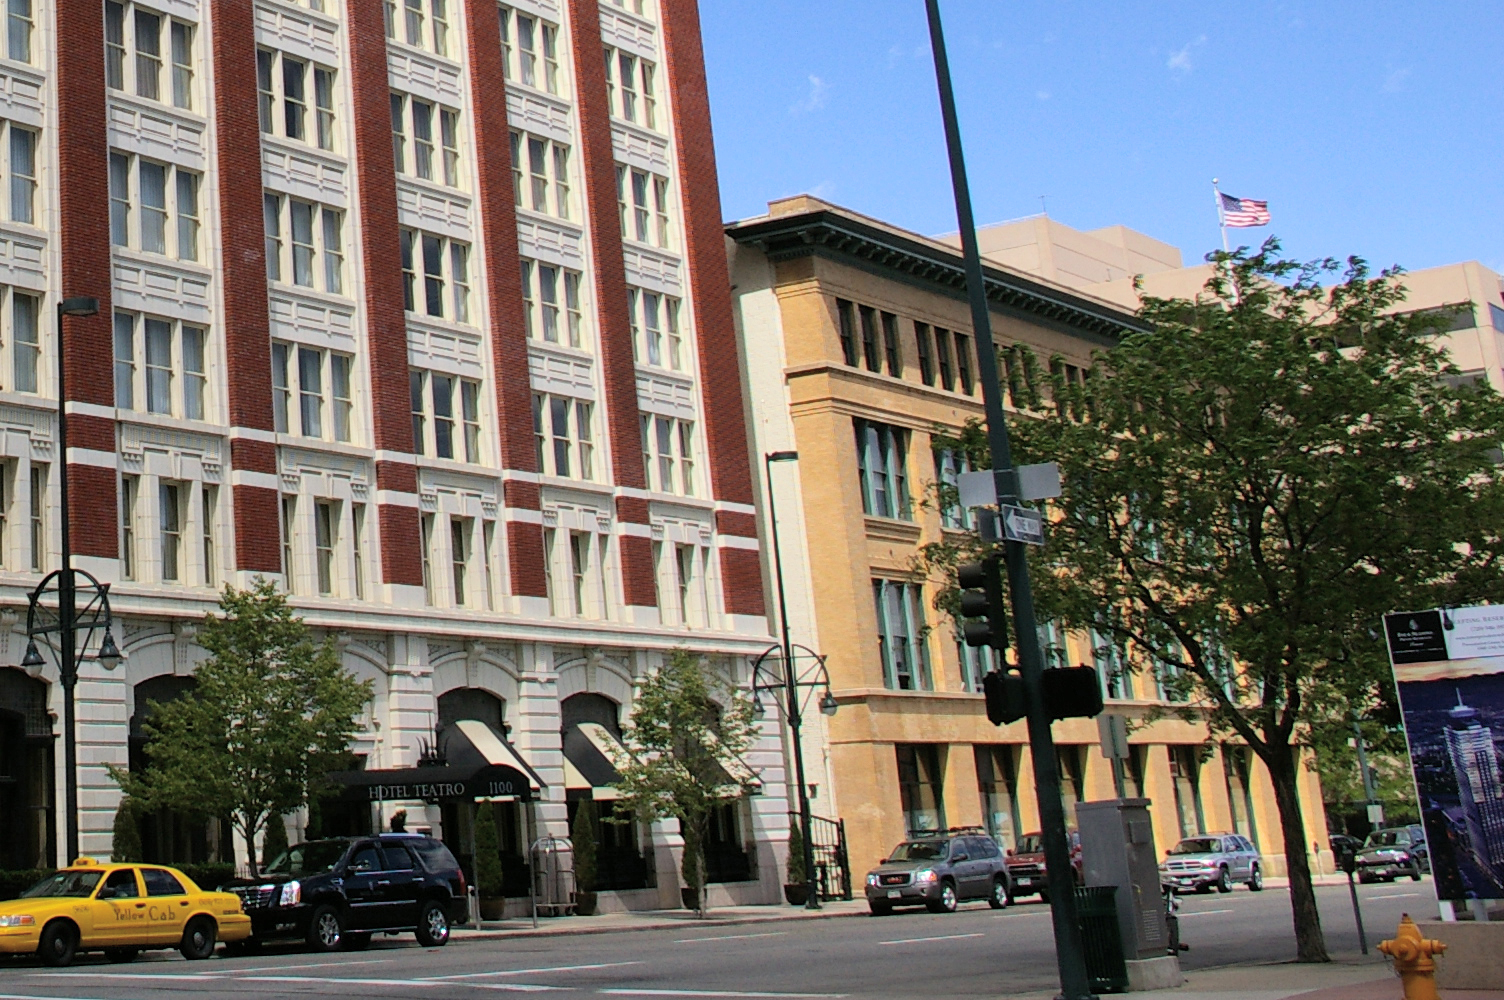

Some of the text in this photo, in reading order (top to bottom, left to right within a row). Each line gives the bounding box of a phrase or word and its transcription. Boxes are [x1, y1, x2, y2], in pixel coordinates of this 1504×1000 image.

[369, 782, 465, 799] HOTEL TEATRO
[489, 781, 513, 794] 1100
[113, 904, 176, 922] Yellow Cab
